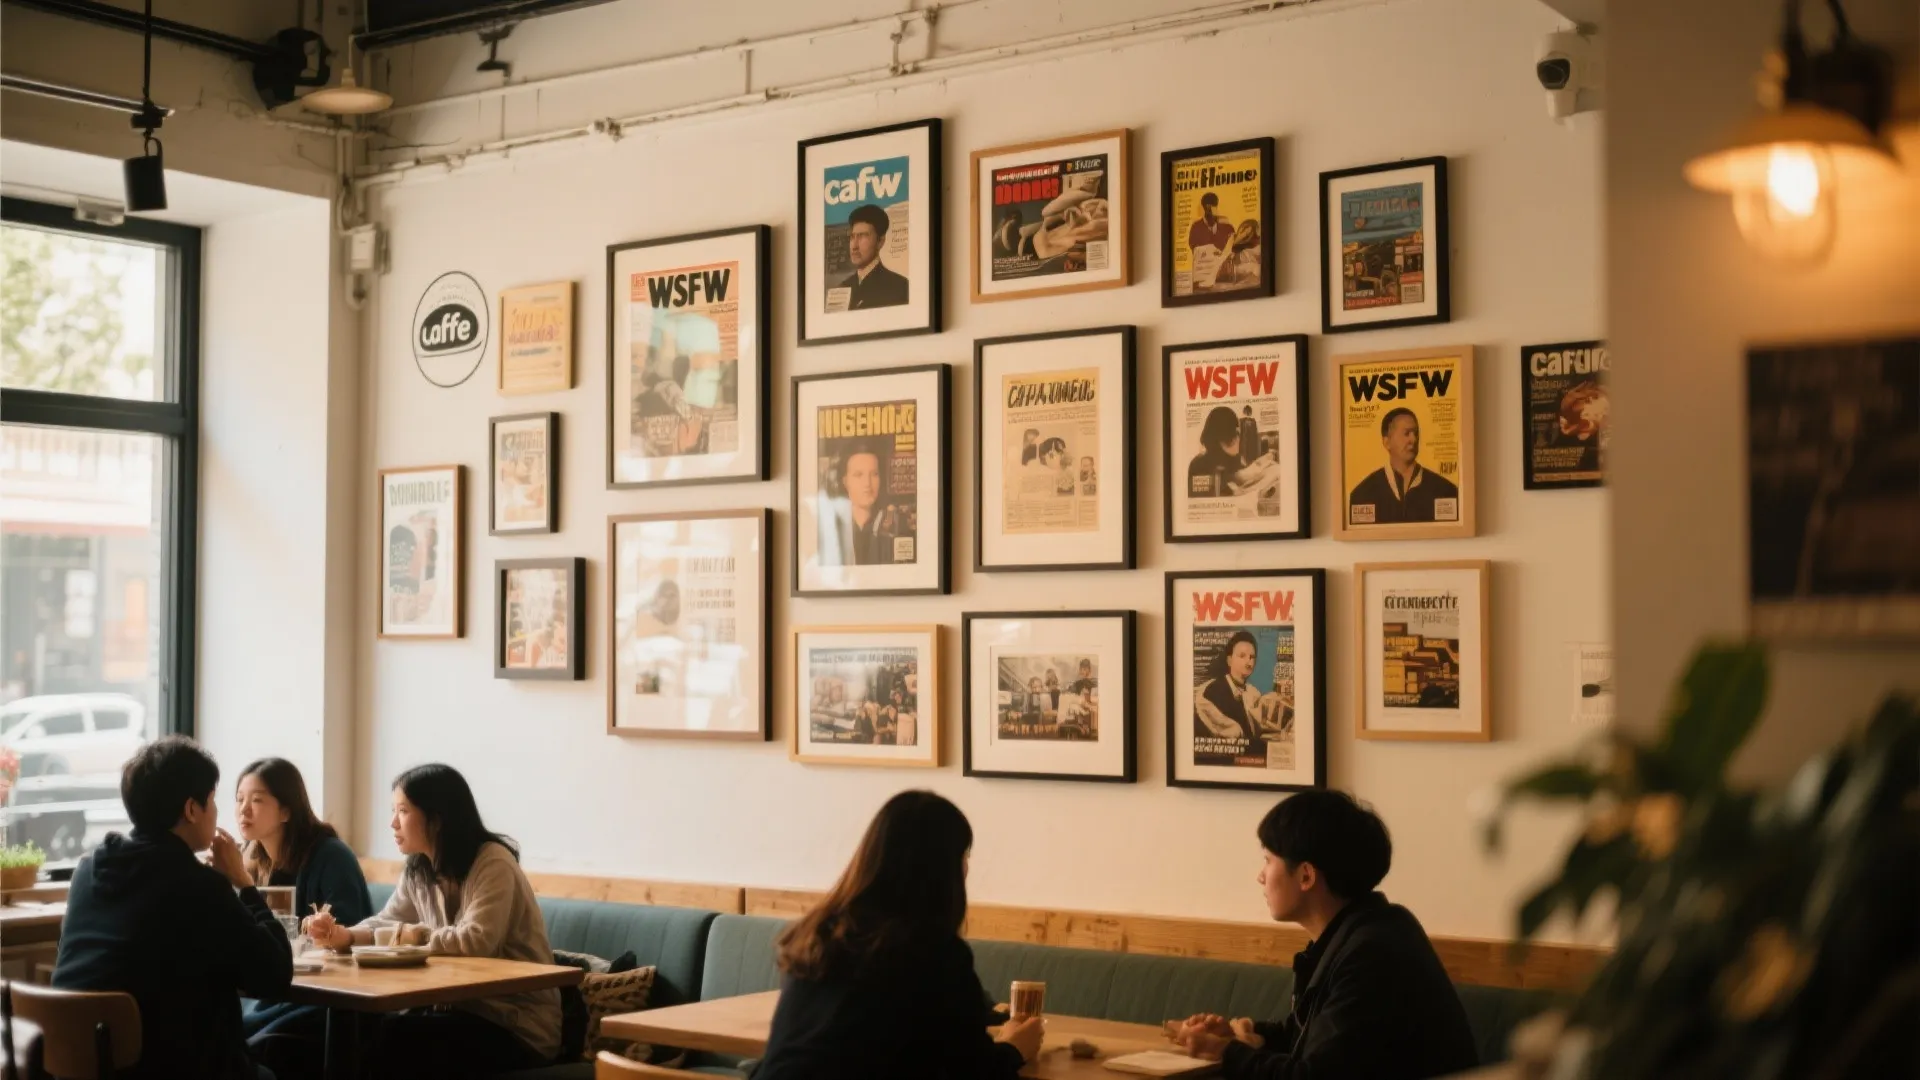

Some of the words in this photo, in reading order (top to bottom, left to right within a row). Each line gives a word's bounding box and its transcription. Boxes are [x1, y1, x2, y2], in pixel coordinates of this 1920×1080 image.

[824, 166, 903, 205] cafw
[648, 268, 731, 309] WSFW
[1184, 361, 1280, 400] WSFW
[1348, 370, 1453, 403] WSFW
[1193, 590, 1295, 622] WSFW
